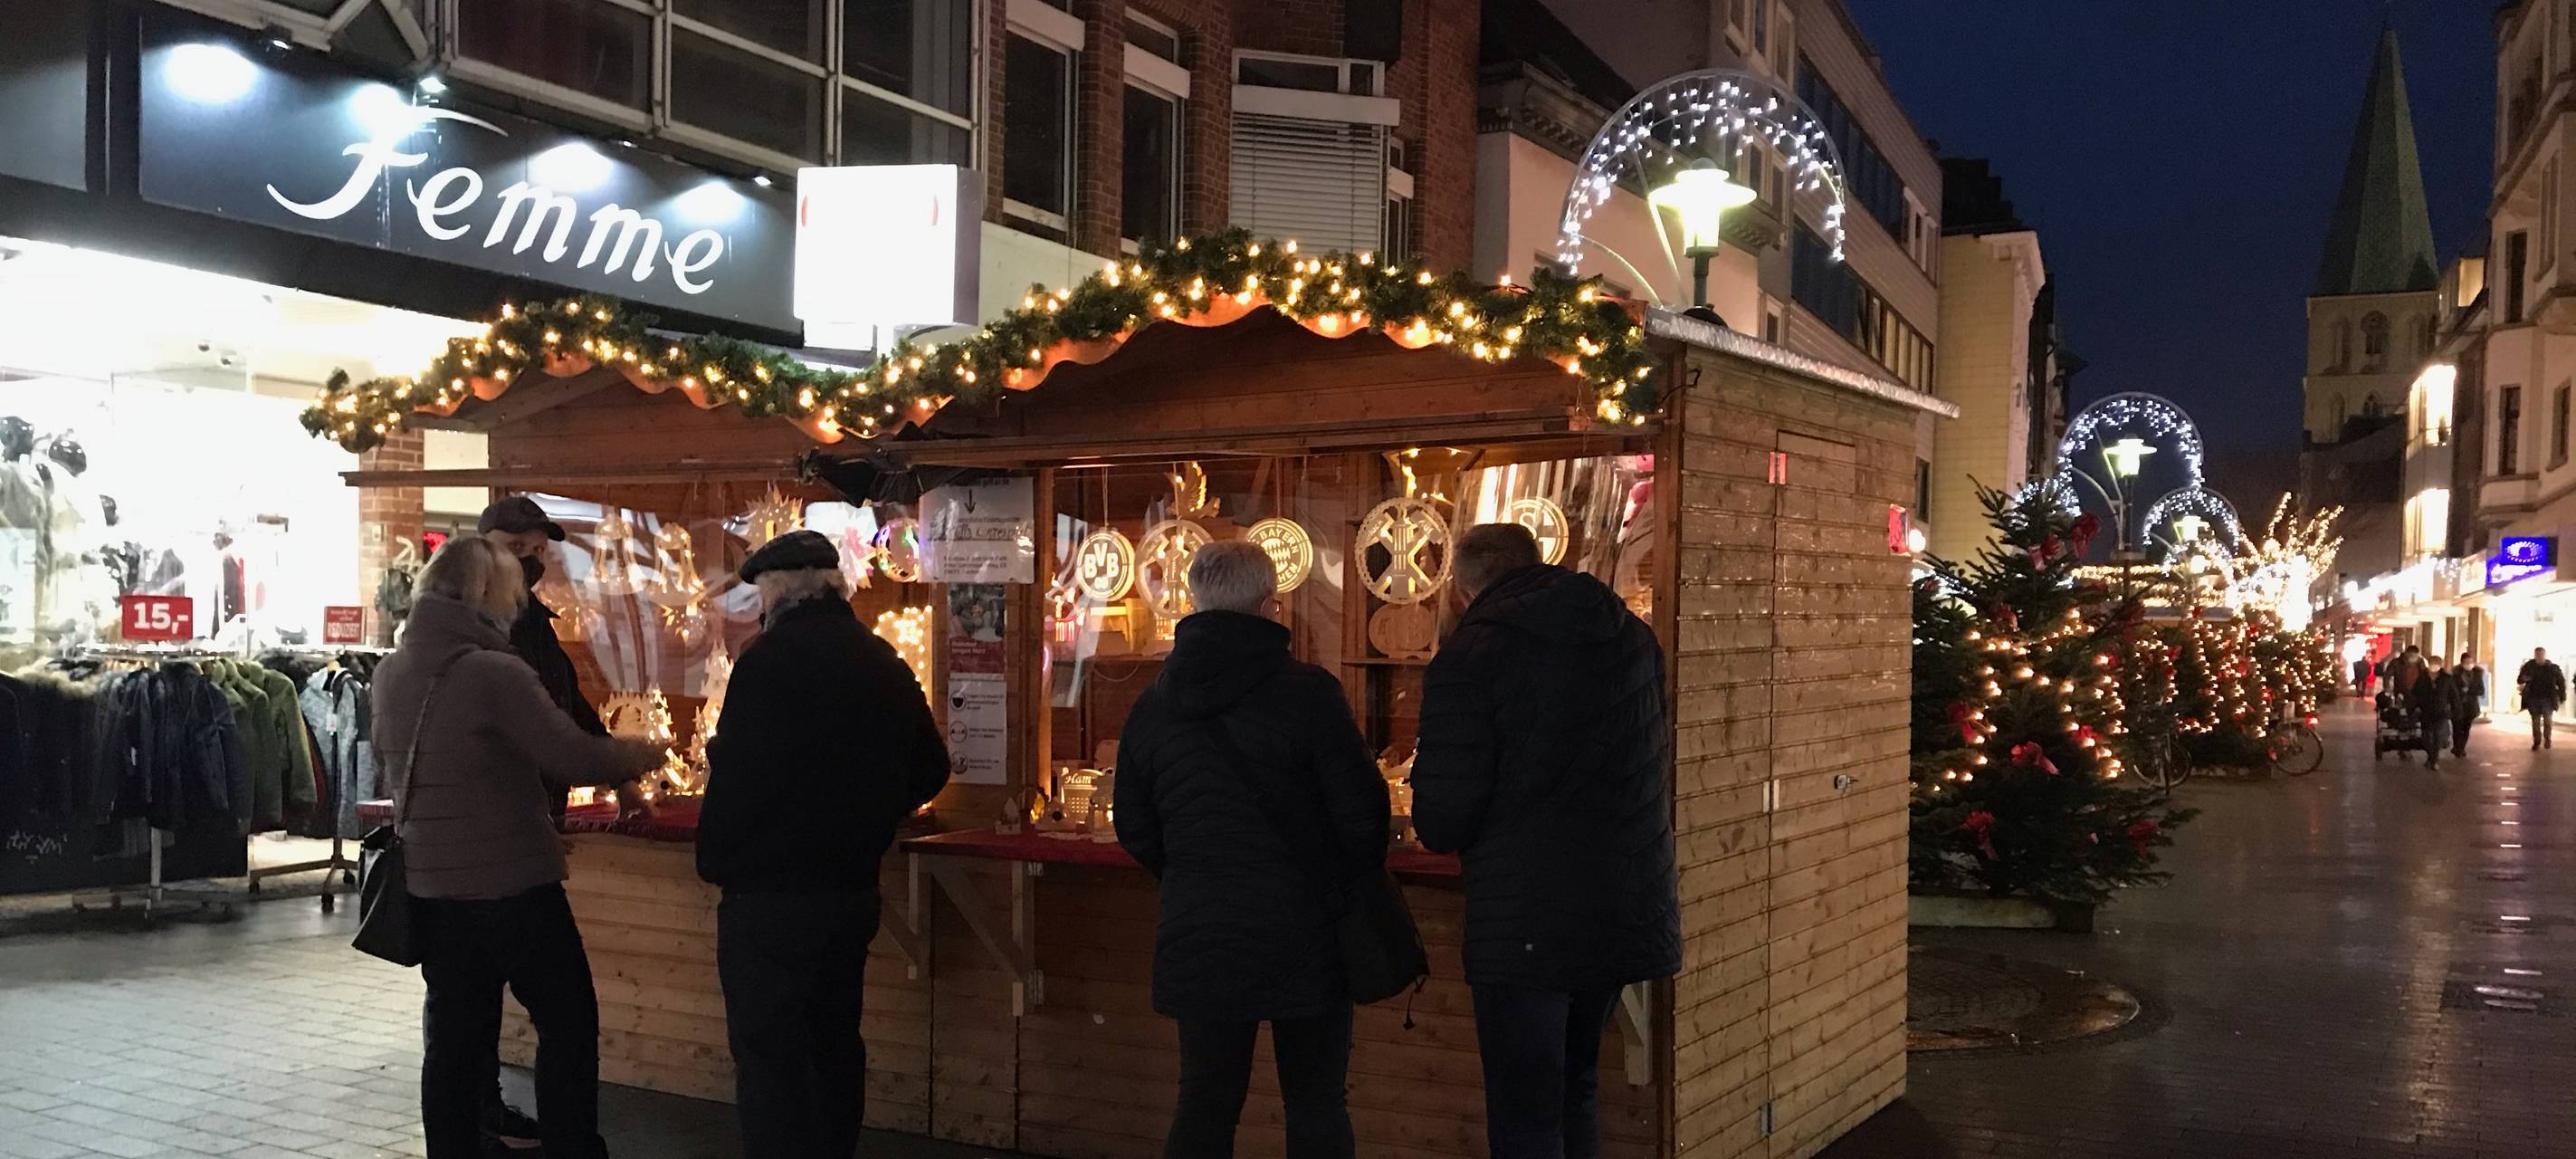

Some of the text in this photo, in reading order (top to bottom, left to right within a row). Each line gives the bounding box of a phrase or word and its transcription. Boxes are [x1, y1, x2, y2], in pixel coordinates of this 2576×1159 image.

[267, 106, 725, 295] Femme
[1259, 528, 1300, 554] BAYERN
[1084, 542, 1120, 579] BVB
[133, 601, 189, 635] 15,-
